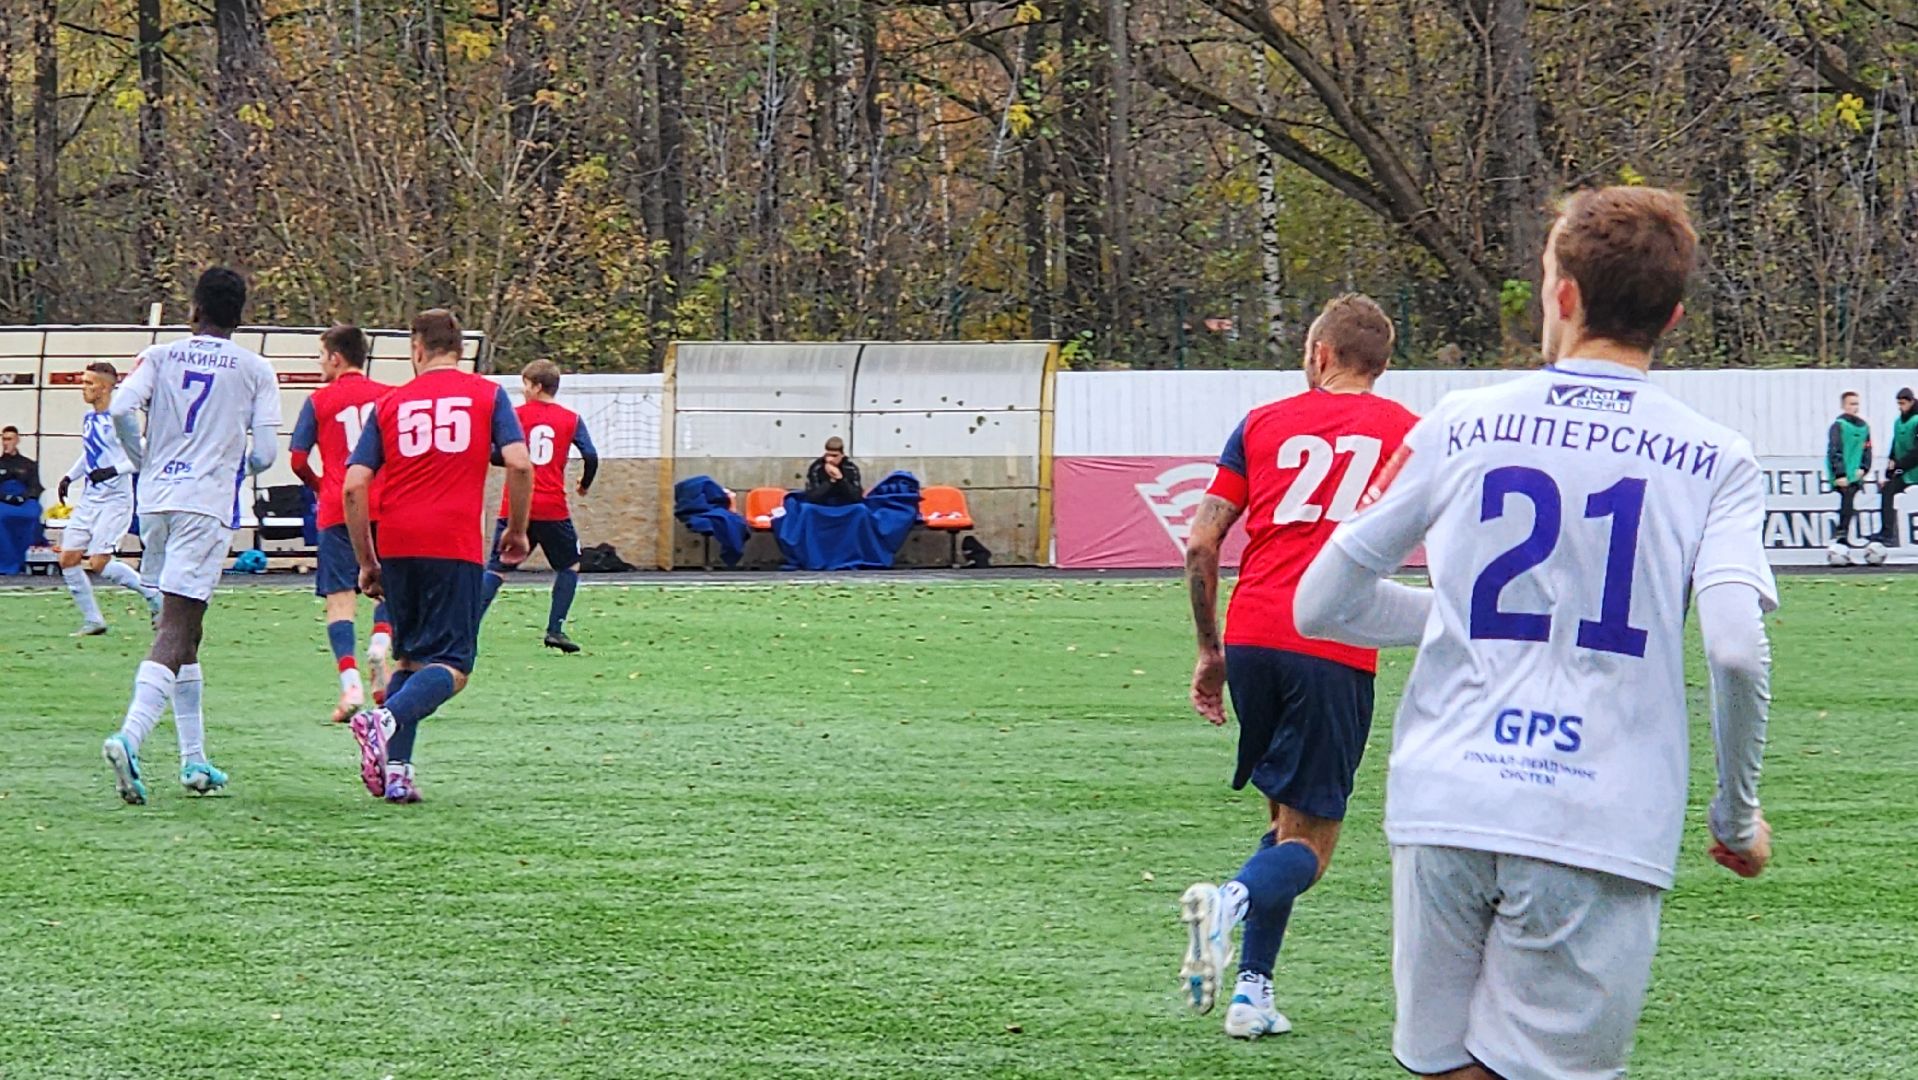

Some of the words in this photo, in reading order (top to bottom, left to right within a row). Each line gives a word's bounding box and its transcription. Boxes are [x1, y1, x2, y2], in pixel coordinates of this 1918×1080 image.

[167, 350, 238, 369] МАКИНДЕ
[182, 370, 215, 433] 7
[335, 401, 376, 453] 1
[397, 396, 473, 457] 55
[163, 460, 193, 475] GPS
[529, 424, 555, 465] 6
[1447, 414, 1719, 480] КАШПЕРСКИЙ
[1273, 434, 1382, 525] 27
[1470, 466, 1648, 658] 21
[1495, 709, 1583, 752] GPS
